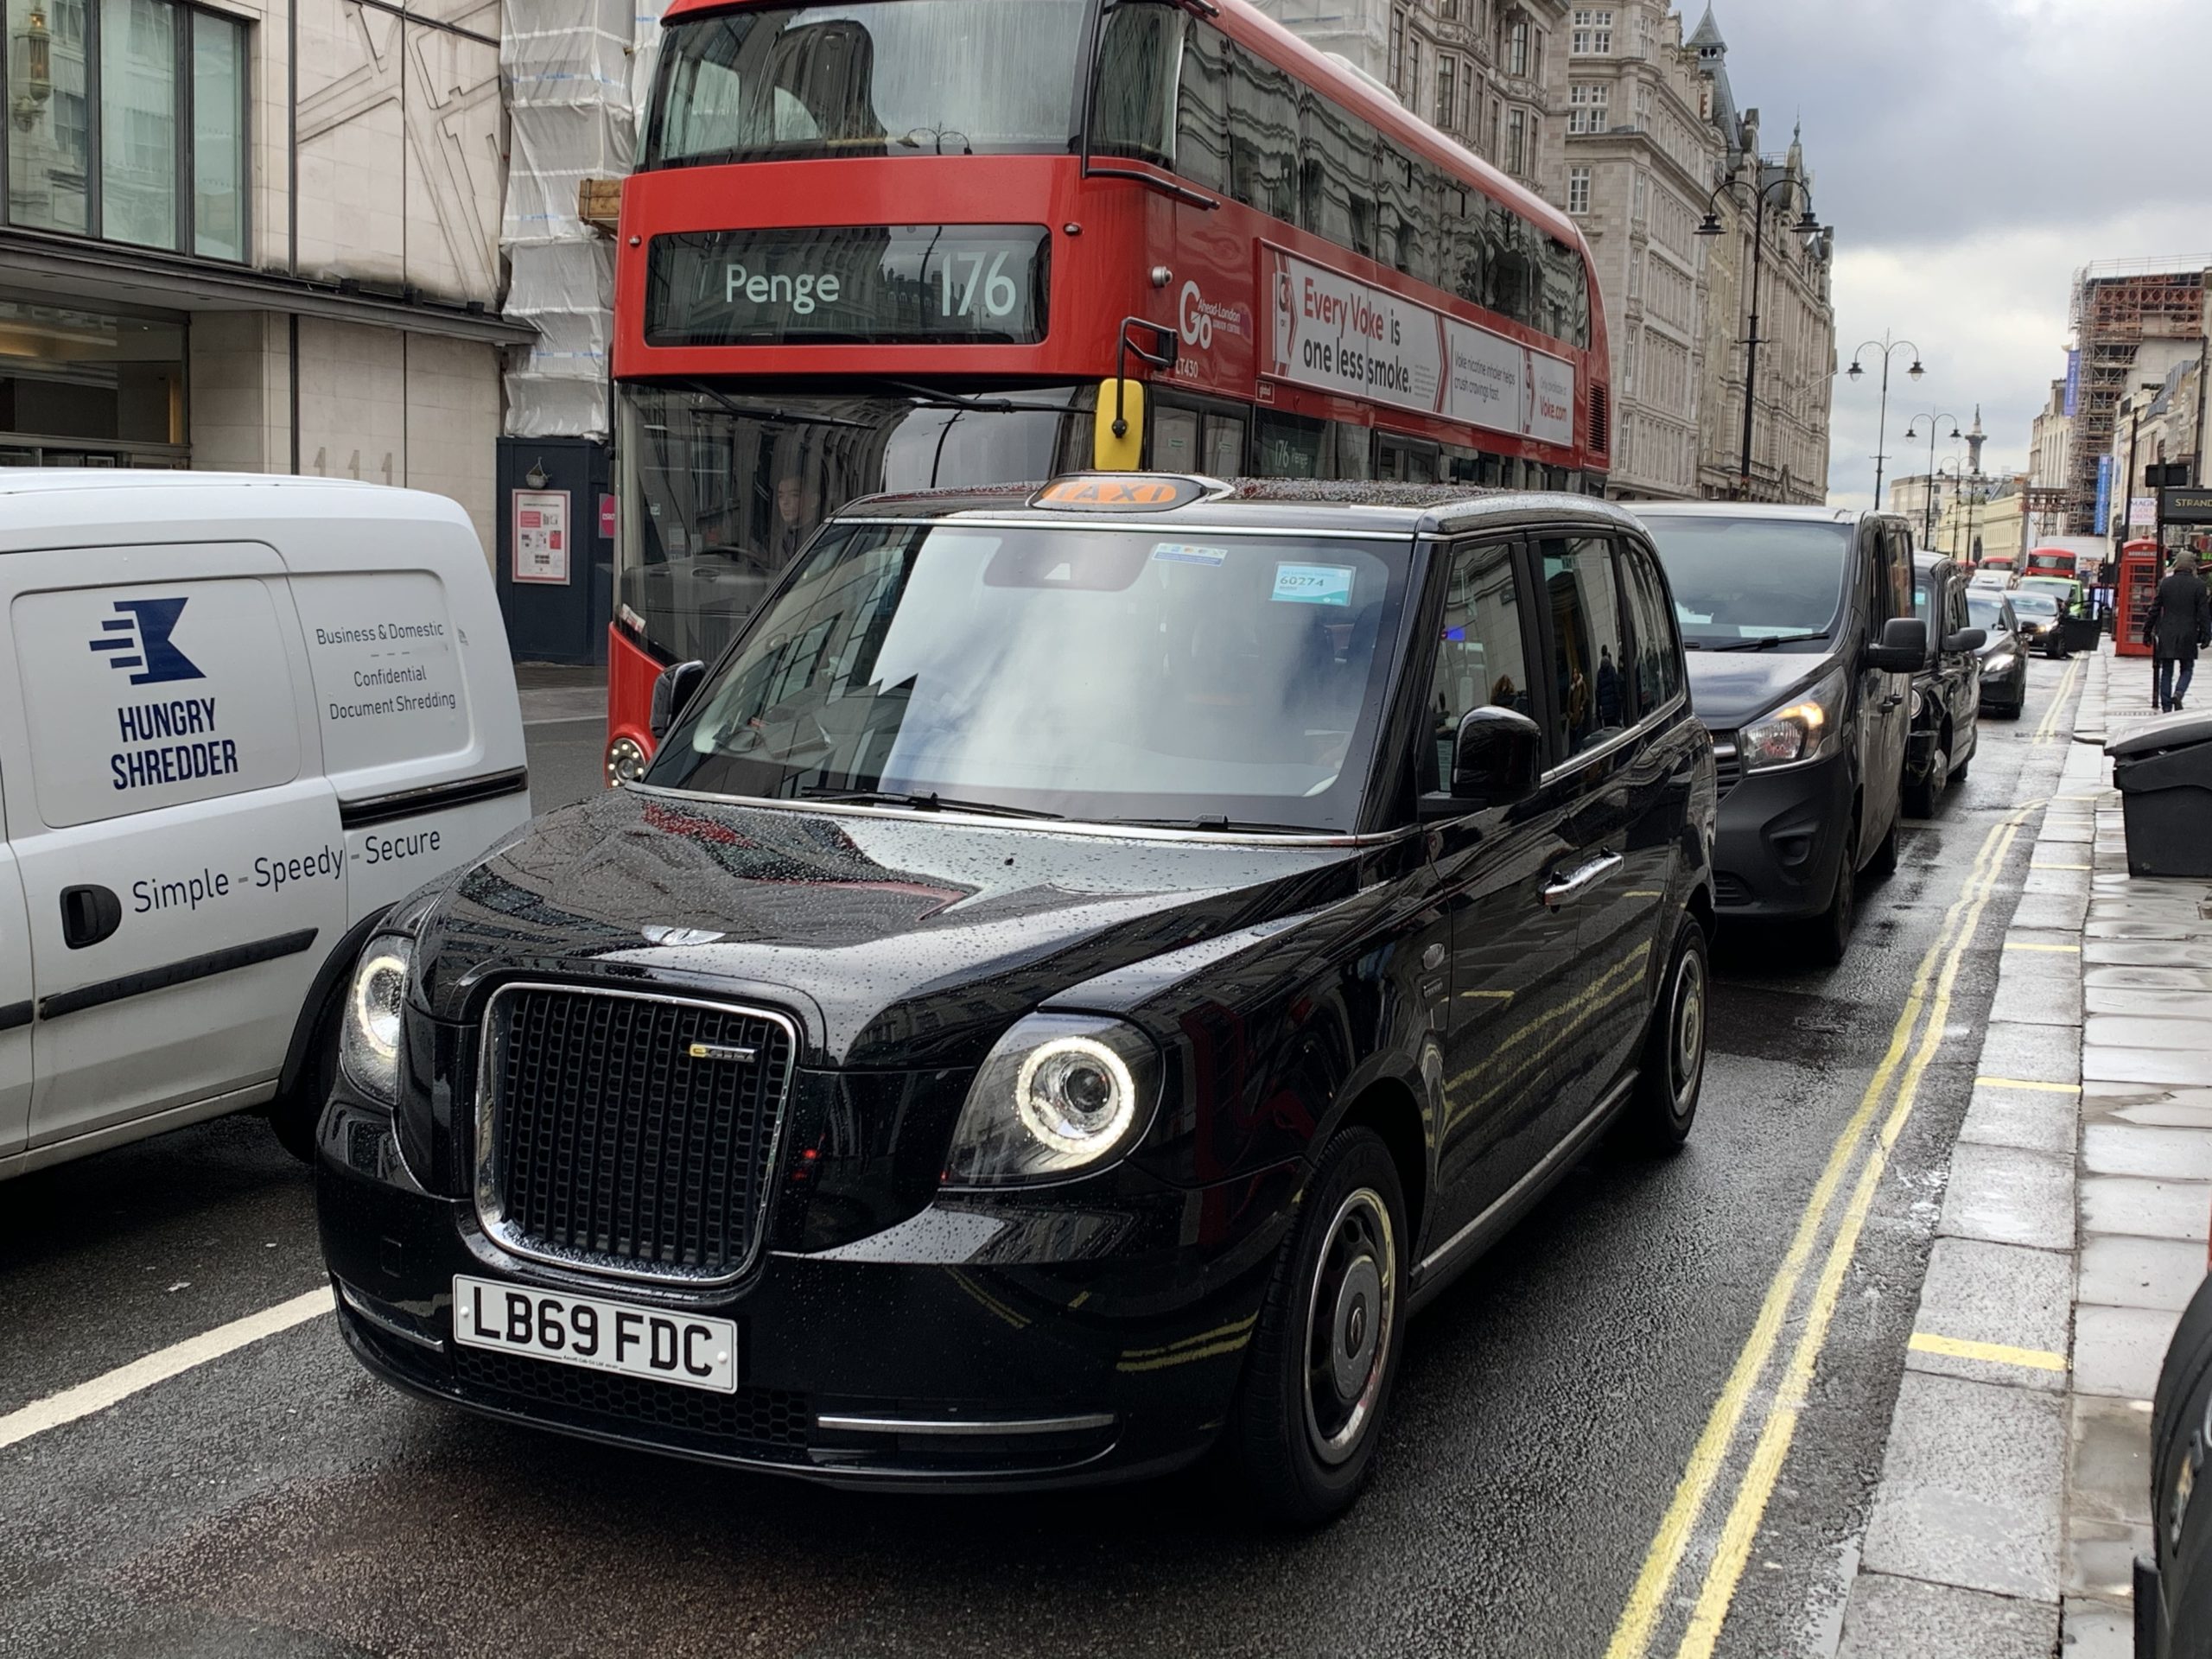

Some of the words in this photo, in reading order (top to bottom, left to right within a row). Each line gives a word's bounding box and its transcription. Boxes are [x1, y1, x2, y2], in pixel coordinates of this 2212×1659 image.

[726, 264, 840, 315] Penge
[941, 251, 1017, 317] 176
[1179, 279, 1212, 351] Go
[1304, 276, 1348, 339] Every
[1351, 292, 1384, 341] Voke
[1390, 308, 1402, 346] is
[1303, 338, 1332, 373] one
[1336, 336, 1364, 381] less
[1368, 354, 1412, 394] smoke.
[1454, 350, 1467, 370] Voke
[1467, 355, 1486, 377] nicotine
[1503, 366, 1516, 388] helps
[1454, 375, 1469, 392] crush
[1274, 440, 1289, 468] 176
[1055, 482, 1169, 503] TAXI
[2175, 498, 2212, 508] STRAND
[1280, 575, 1325, 587] 60274
[316, 626, 377, 645] Business
[378, 624, 388, 640] &
[388, 620, 444, 639] Domestic
[353, 665, 427, 688] Confidential
[118, 696, 215, 743] HUNGRY
[329, 697, 395, 720] Document
[396, 691, 456, 712] Shredding
[111, 739, 238, 791] SHREDDER
[132, 867, 230, 913] Simple
[254, 843, 344, 893] Speedy
[365, 830, 442, 865] Secure
[474, 1286, 599, 1357] LB69
[615, 1311, 713, 1377] FDC
